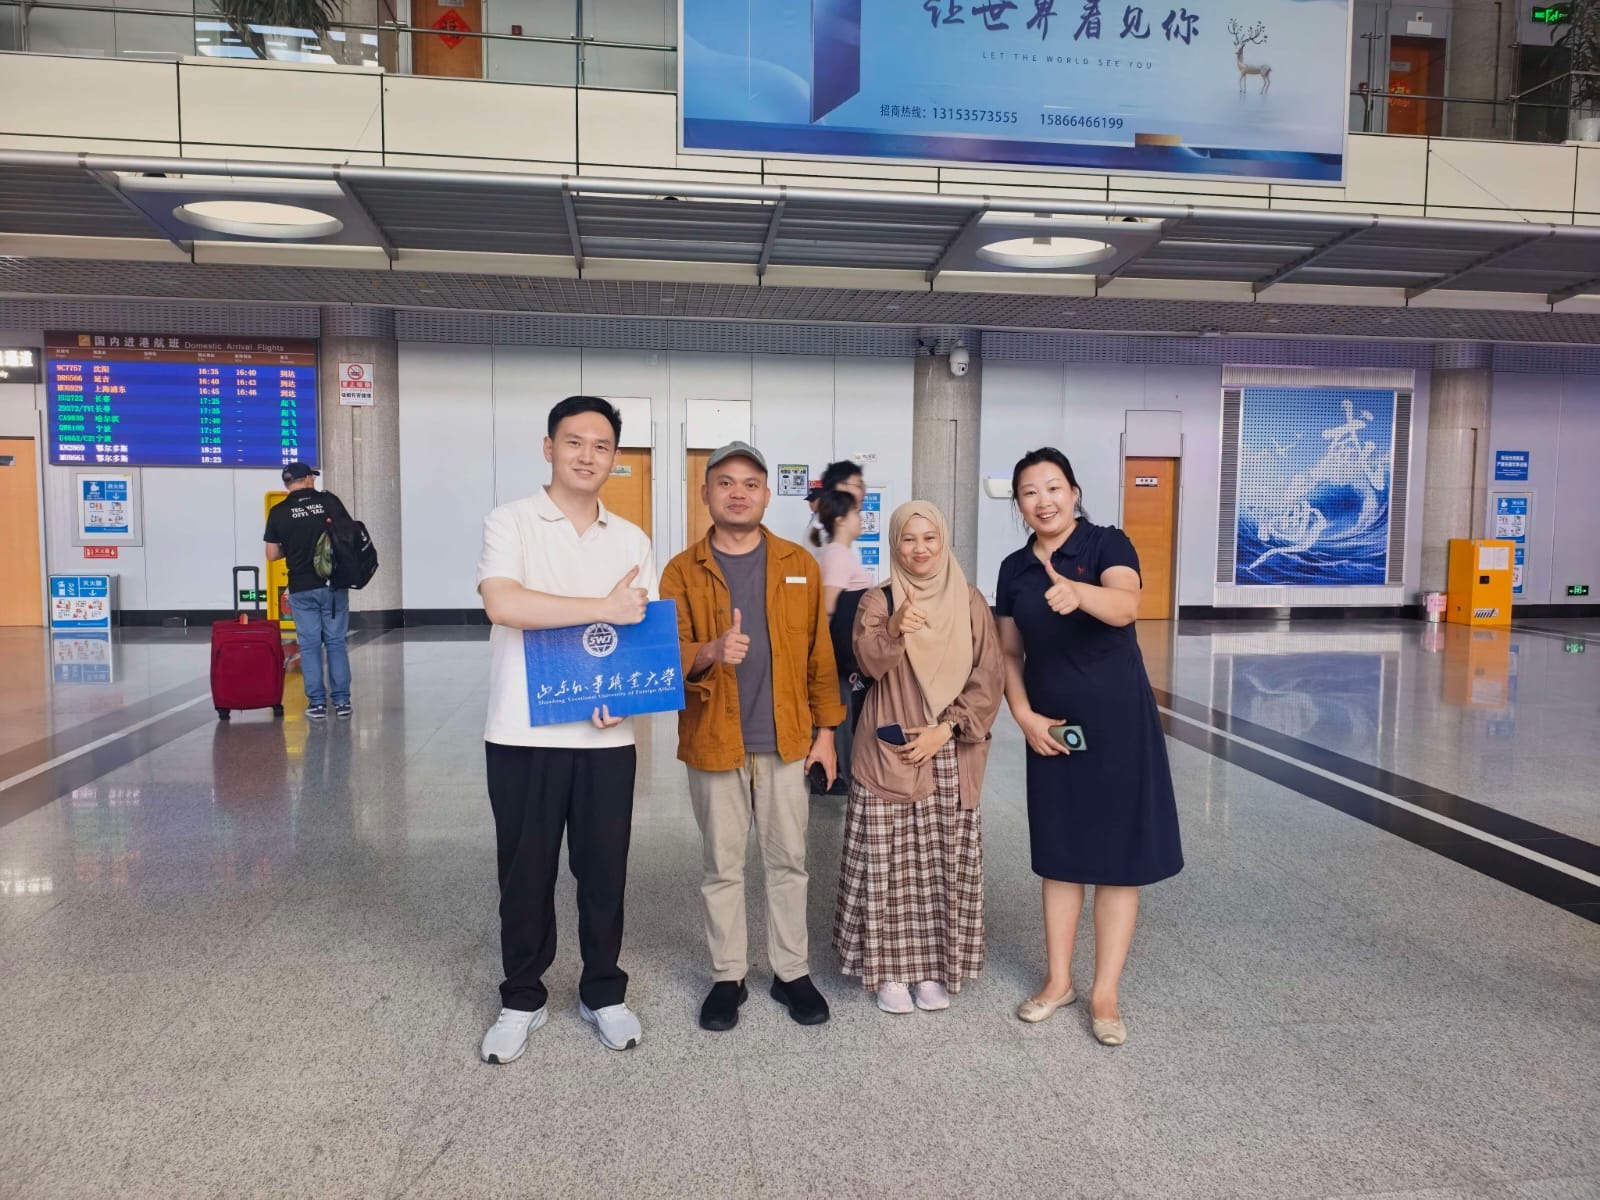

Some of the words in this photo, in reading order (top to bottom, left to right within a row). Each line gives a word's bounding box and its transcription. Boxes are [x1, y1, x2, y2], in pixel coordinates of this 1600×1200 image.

[982, 51, 1005, 60] LET
[1014, 53, 1038, 63] THE
[1046, 55, 1089, 65] WORLD
[1098, 58, 1120, 67] SEE
[1129, 60, 1153, 69] YOU
[1040, 113, 1124, 130] 15866466199
[94, 335, 180, 349] 国内进港航班
[184, 341, 222, 350] Domestic
[226, 343, 253, 351] Arrival
[258, 344, 284, 353] Flights
